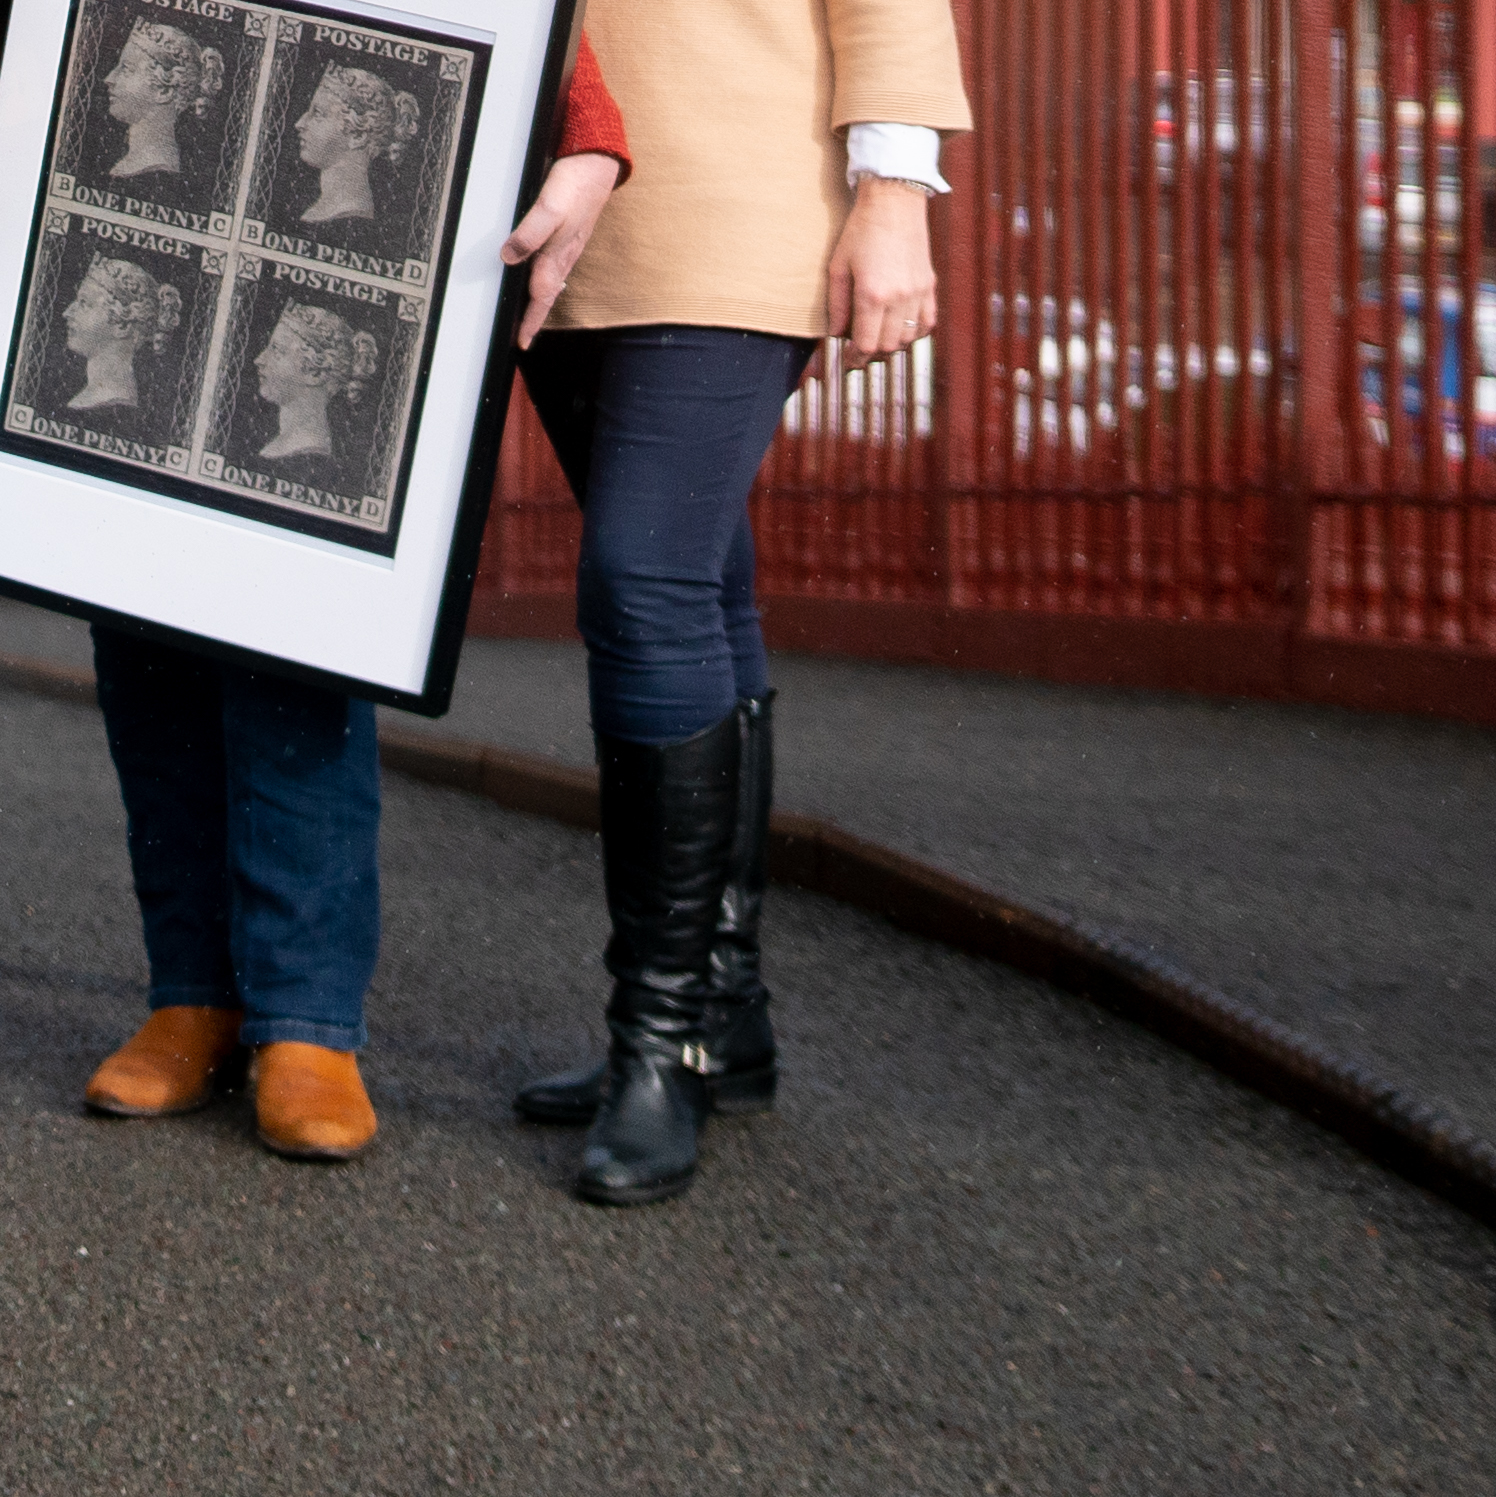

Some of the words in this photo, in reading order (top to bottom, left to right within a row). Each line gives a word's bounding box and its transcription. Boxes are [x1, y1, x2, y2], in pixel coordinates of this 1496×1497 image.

[313, 24, 429, 67] POSTAGE
[81, 217, 191, 260] POSTAGE
[272, 262, 388, 307] POSTAGE
